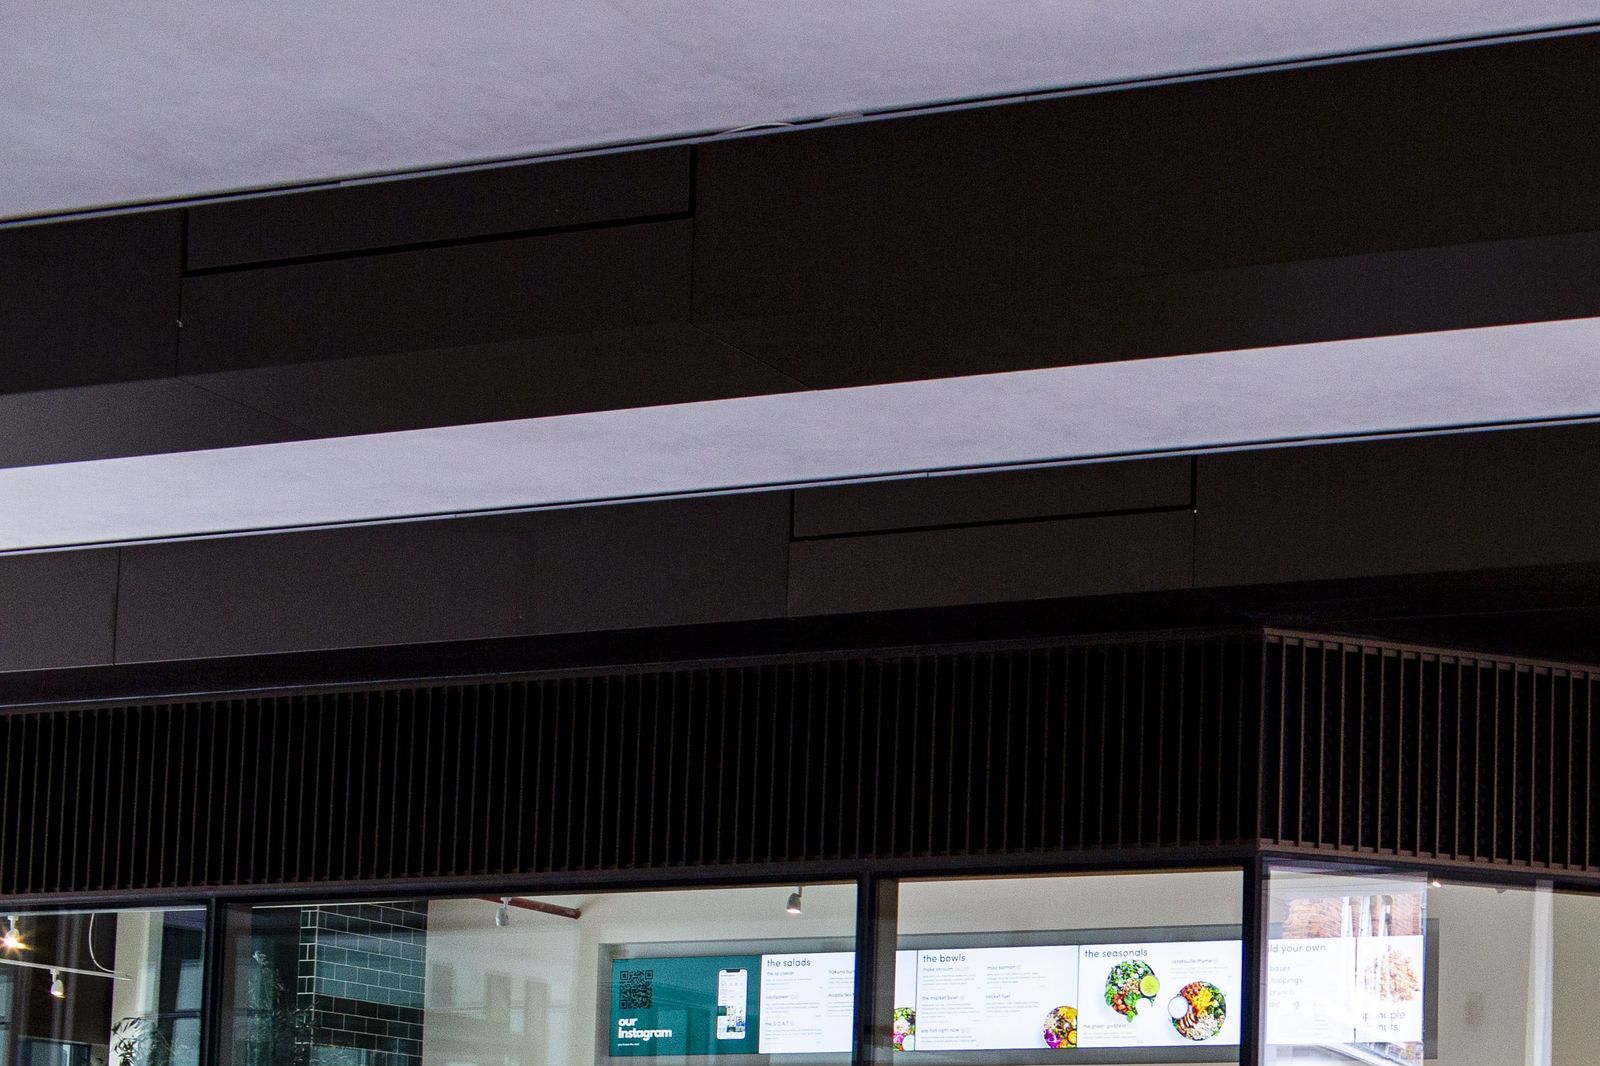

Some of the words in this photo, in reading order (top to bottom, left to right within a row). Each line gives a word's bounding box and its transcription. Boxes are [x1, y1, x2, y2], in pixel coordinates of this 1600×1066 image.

[1084, 949, 1100, 958] the
[1102, 948, 1148, 958] seasonals
[1281, 944, 1303, 955] your
[1305, 944, 1326, 952] own
[767, 958, 781, 967] the
[783, 957, 811, 967] salads
[922, 954, 938, 963] the
[939, 953, 966, 963] bowls
[618, 1018, 639, 1027] our
